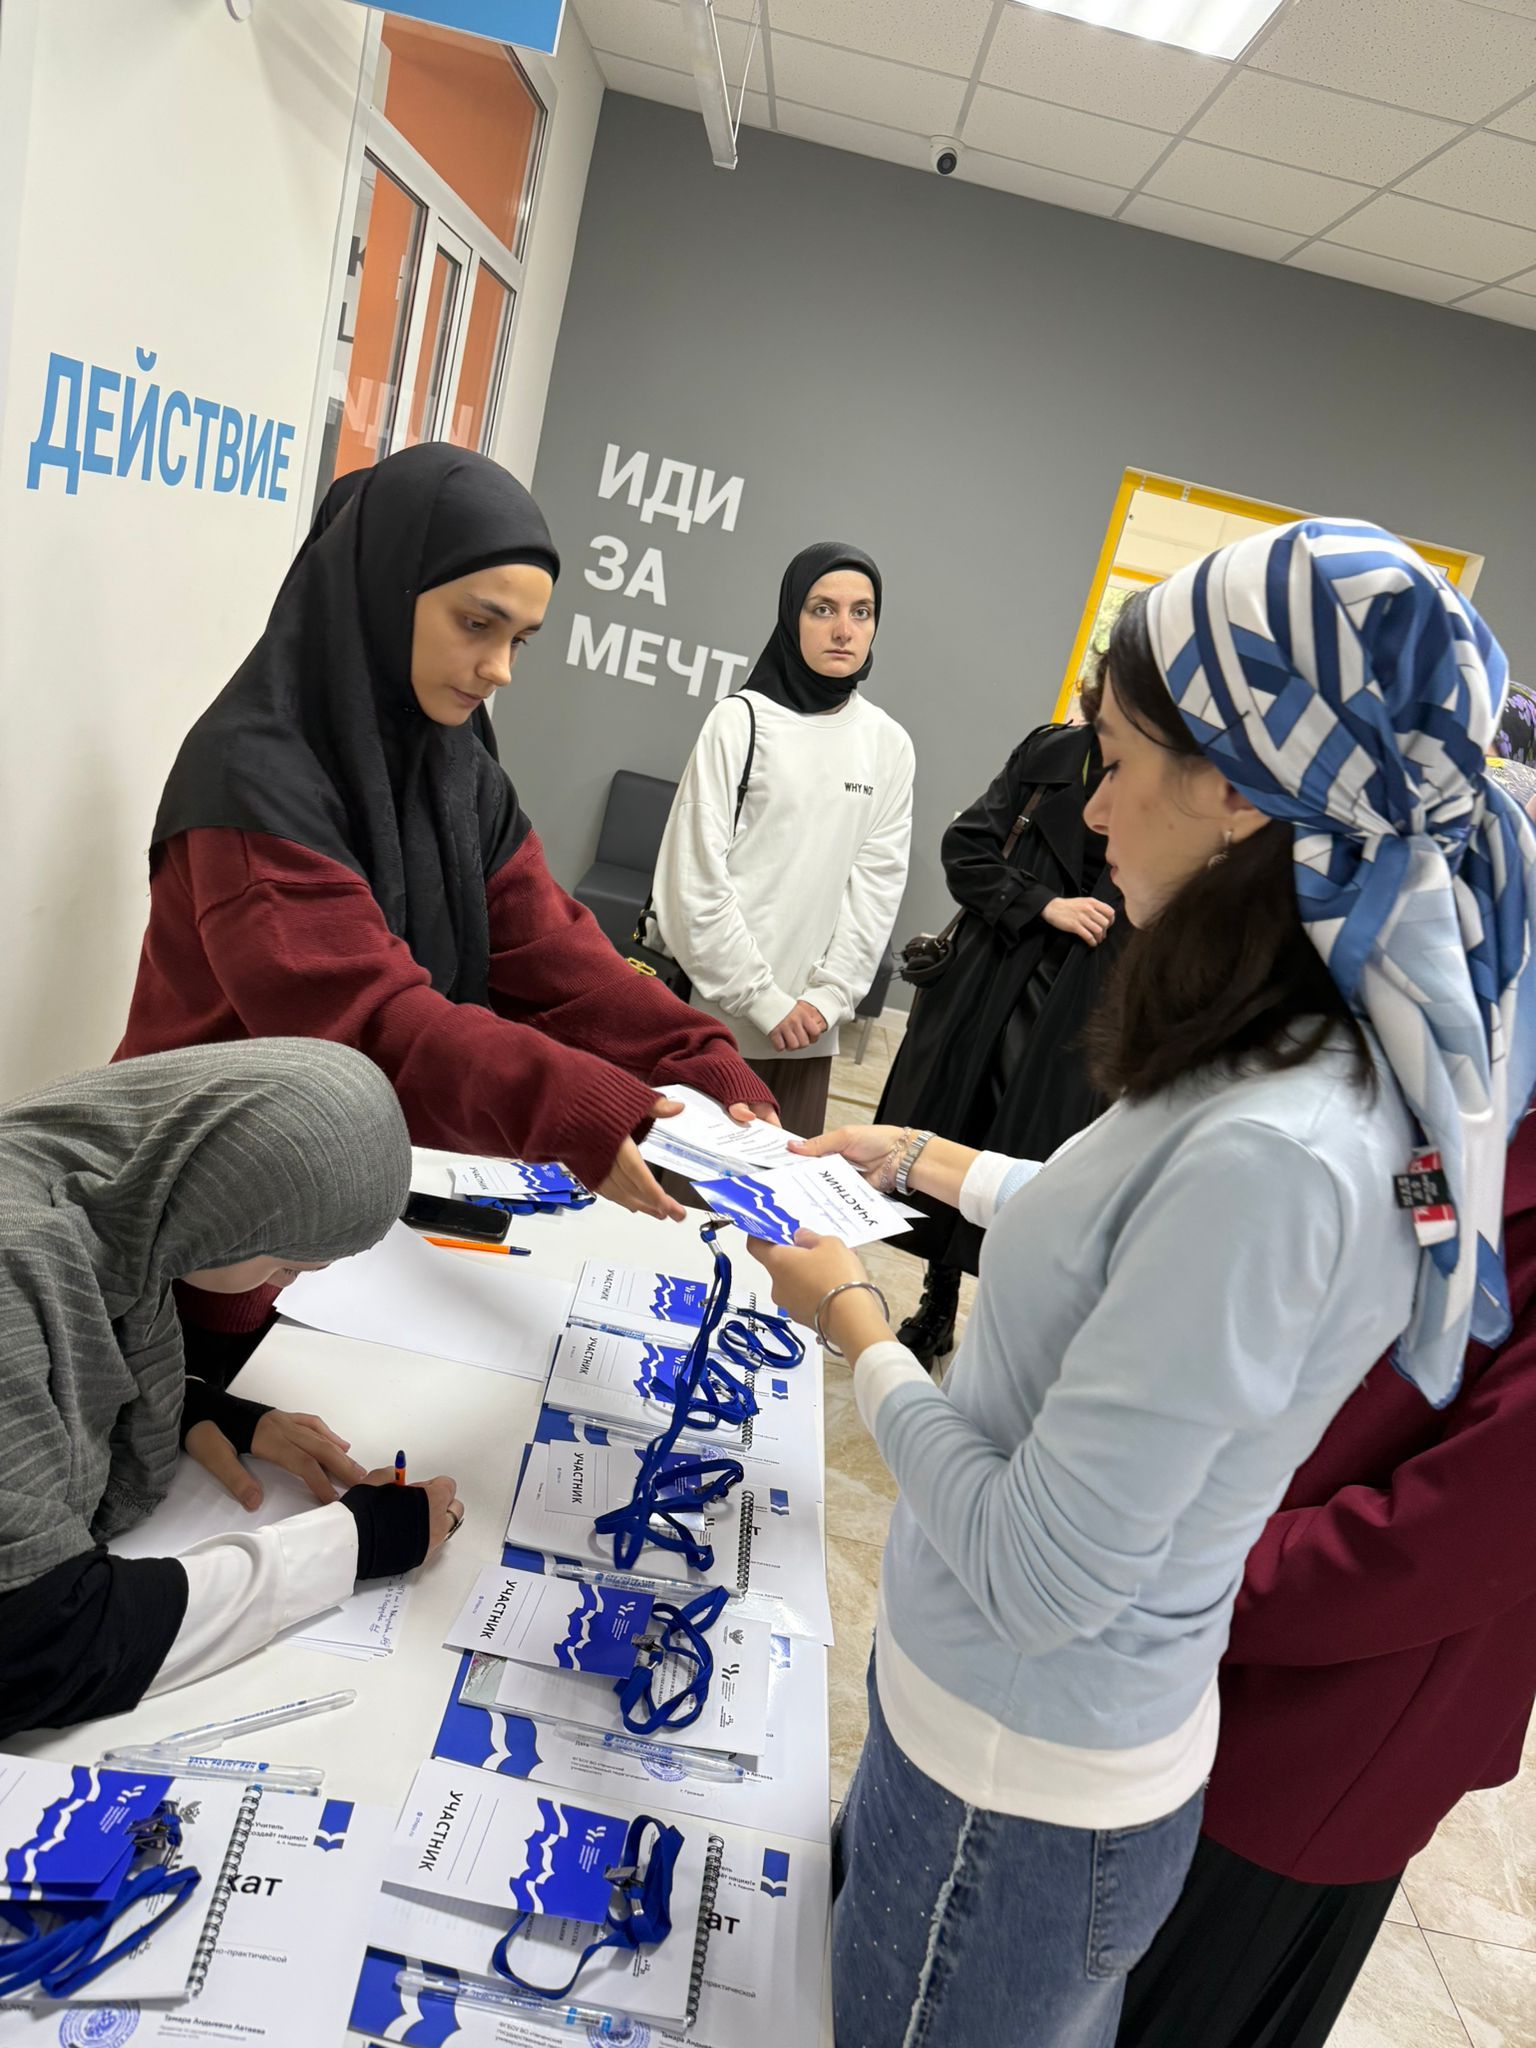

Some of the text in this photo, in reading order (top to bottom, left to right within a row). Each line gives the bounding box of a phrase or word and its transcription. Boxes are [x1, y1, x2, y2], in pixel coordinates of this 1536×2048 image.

[26, 346, 296, 502] ДЕЙСТВИЕ
[598, 443, 745, 534] ИДИ
[584, 535, 667, 606] ЗА
[844, 782, 862, 793] WHY
[819, 1169, 879, 1227] УЧАСТНИК
[600, 1269, 615, 1301] УЧАСТНИК
[578, 1336, 598, 1375] УЧАСТНИК
[571, 1452, 584, 1504] УЧАСТНИК
[480, 1580, 518, 1640] УЧАСТНИК
[418, 1790, 464, 1872] УЧАСТНИК
